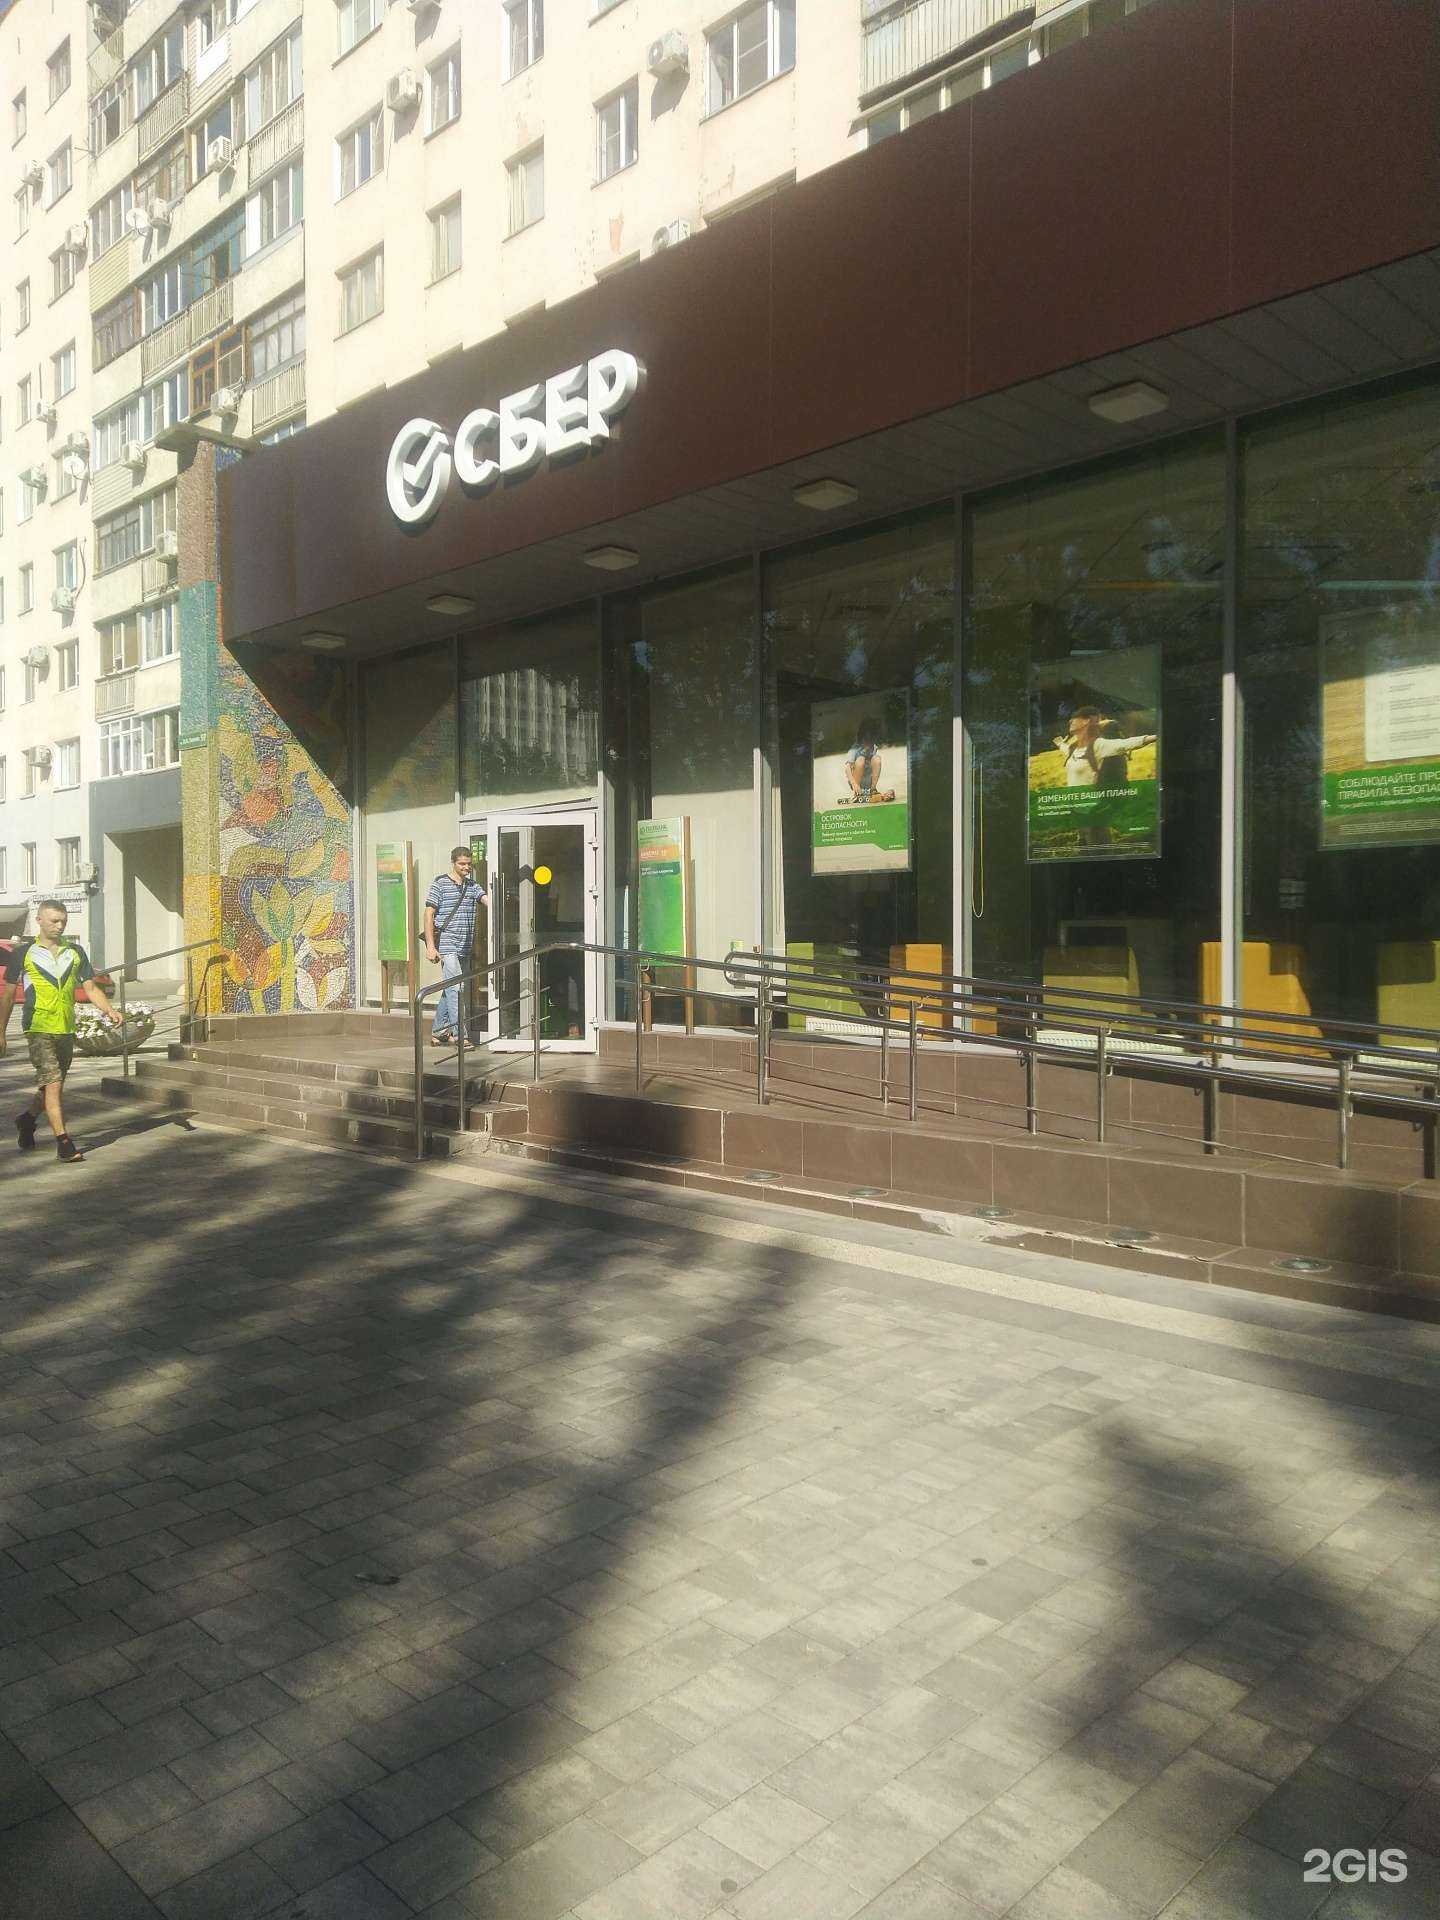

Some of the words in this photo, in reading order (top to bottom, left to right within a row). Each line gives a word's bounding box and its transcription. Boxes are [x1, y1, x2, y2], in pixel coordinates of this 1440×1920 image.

[454, 349, 638, 484] СБЕР
[1338, 772, 1416, 789] СОБЛЮДАЙТЕ
[1038, 792, 1079, 803] ИЗМЕНИТЕ
[1080, 790, 1105, 799] ВАШИ
[1106, 787, 1138, 797] ПЛАНЫ
[1339, 787, 1391, 801] ПРАВИЛА
[821, 813, 852, 822] ОСТРОВОК
[821, 820, 868, 830] БЕЗОПАСНОСТИ
